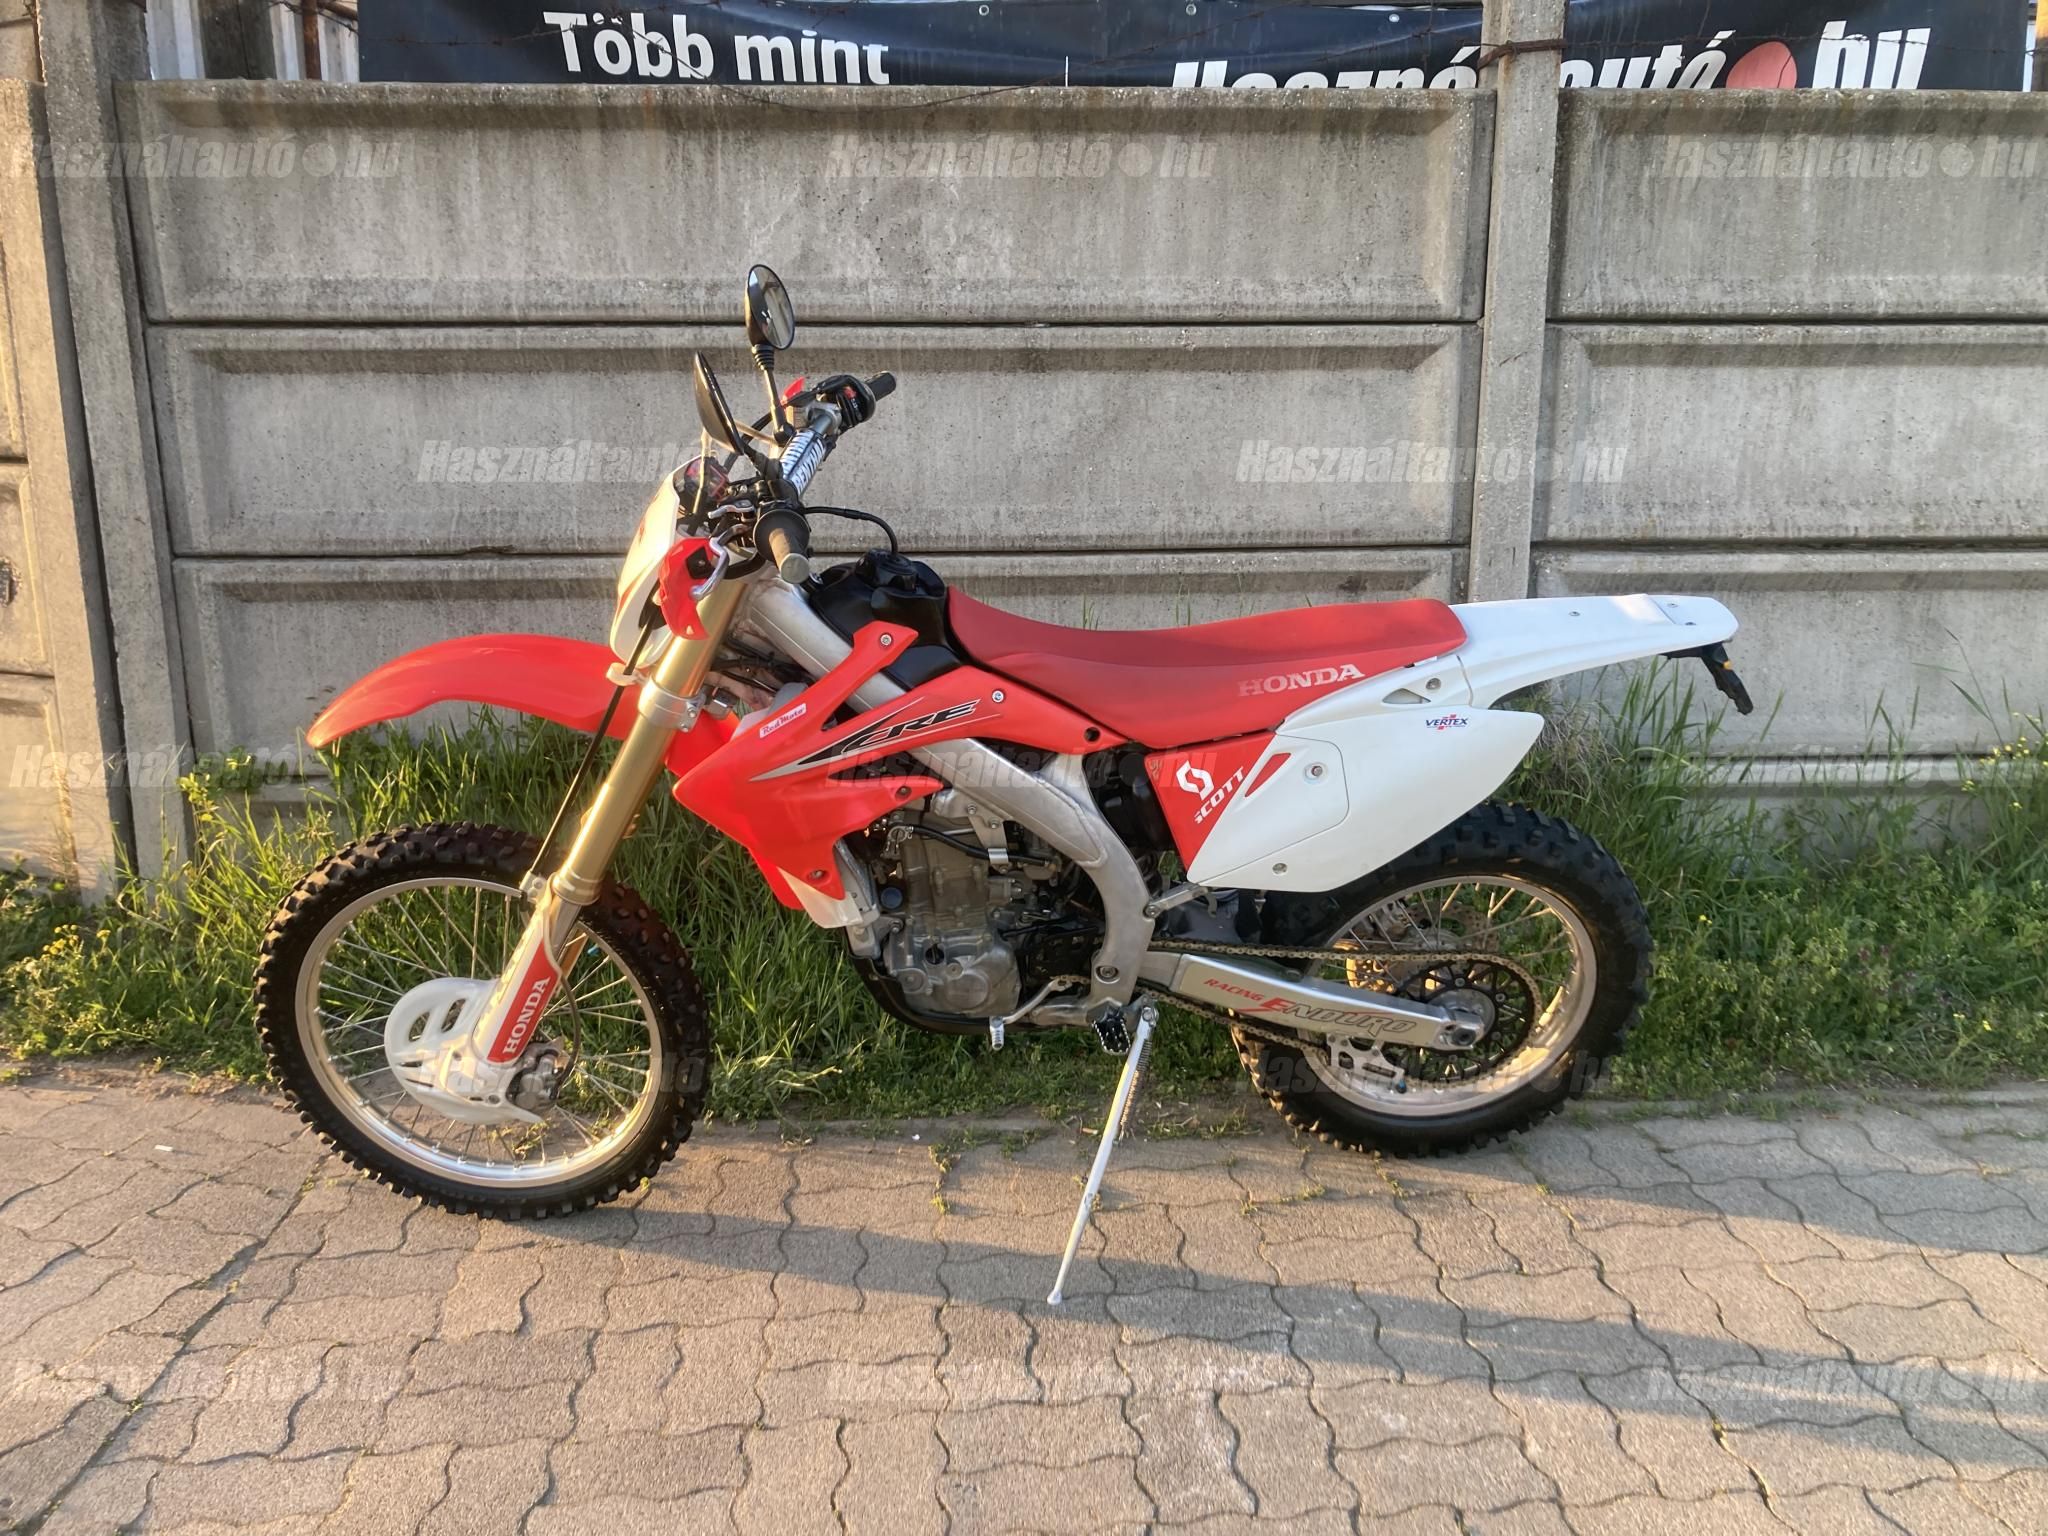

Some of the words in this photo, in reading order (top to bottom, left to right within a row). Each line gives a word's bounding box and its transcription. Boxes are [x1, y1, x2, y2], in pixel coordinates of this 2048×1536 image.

[543, 11, 715, 80] Több
[734, 29, 890, 85] mint
[1238, 663, 1365, 697] HONDA
[1425, 717, 1469, 727] VERTEX
[1194, 766, 1244, 824] SCOTT
[502, 976, 551, 1054] HONDA
[1204, 978, 1265, 1001] RACING
[1260, 997, 1418, 1037] ENDURO
